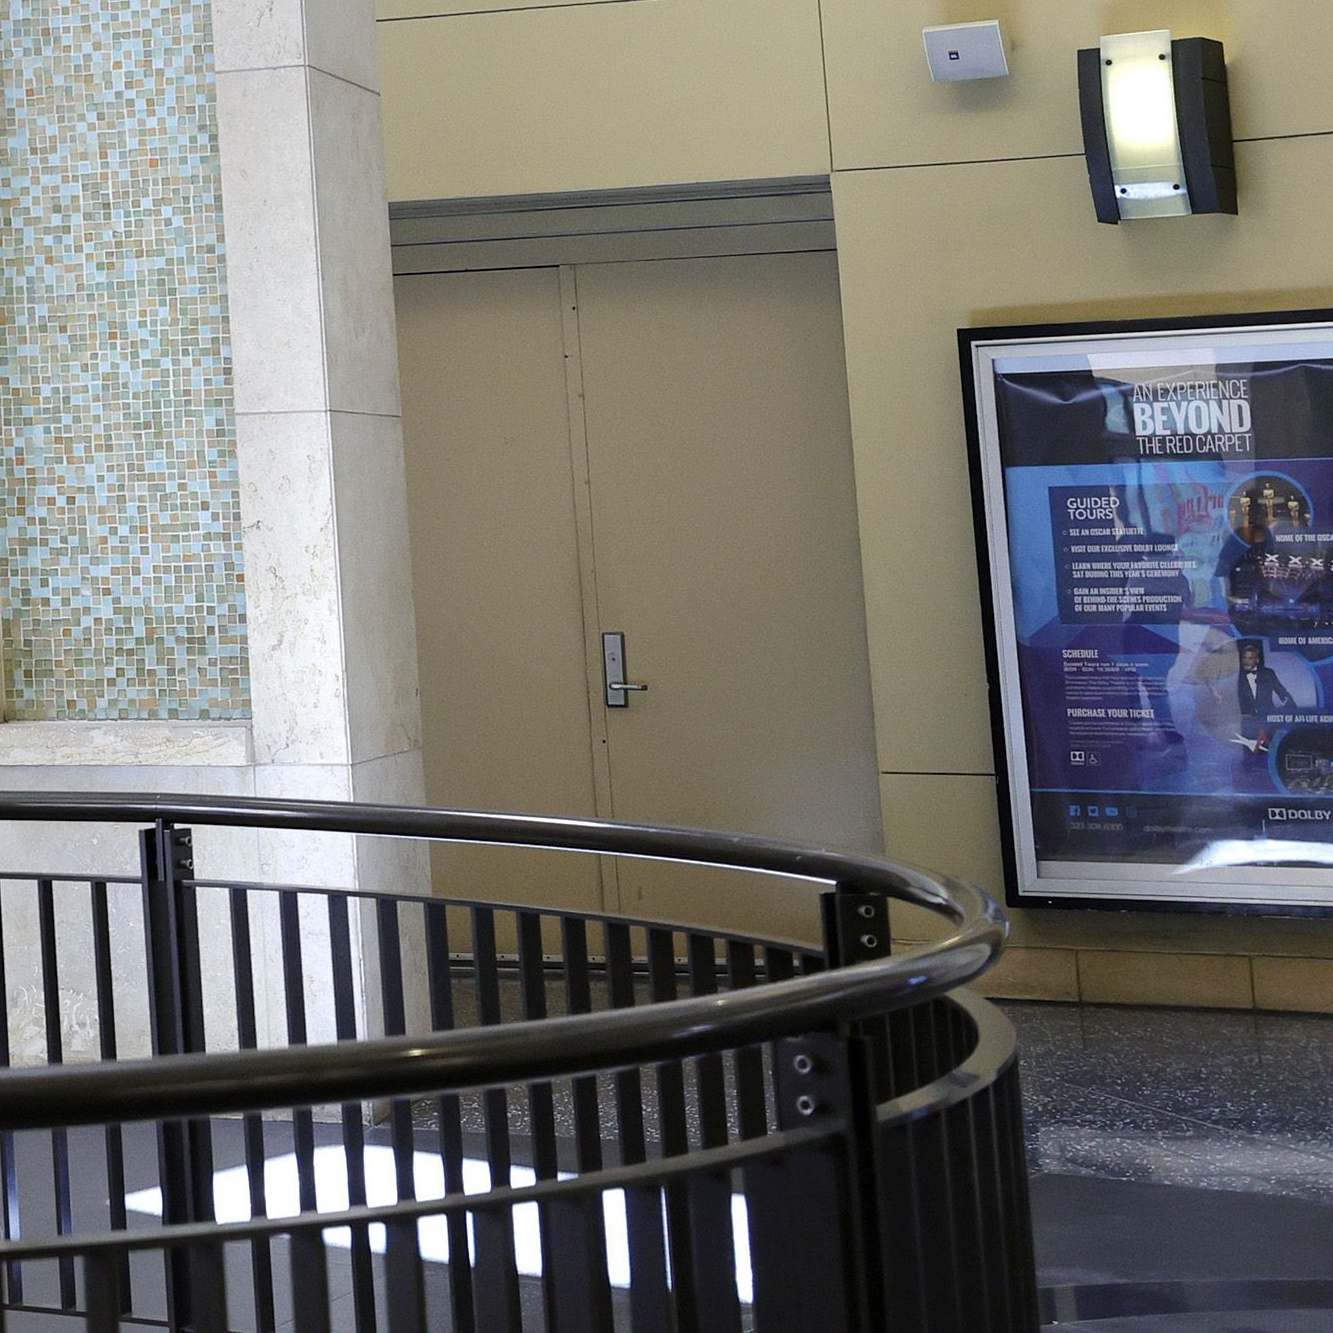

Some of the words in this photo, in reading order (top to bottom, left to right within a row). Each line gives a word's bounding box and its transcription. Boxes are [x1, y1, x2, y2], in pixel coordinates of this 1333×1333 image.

[1133, 384, 1152, 402] AN
[1157, 379, 1249, 402] EXPERIENCE
[1133, 399, 1252, 436] BEYOND
[1136, 436, 1164, 454] THE
[1166, 435, 1193, 454] RED
[1196, 433, 1252, 453] CARPET
[1067, 497, 1120, 509] GUIDED
[1068, 508, 1113, 520] TOURS
[1069, 528, 1079, 536] SEE
[1081, 528, 1090, 536] AN
[1090, 528, 1111, 536] OSCAR
[1275, 534, 1294, 542] HOME
[1295, 534, 1303, 542] OF
[1304, 534, 1316, 542] THE
[1071, 545, 1086, 553] VISIT
[1087, 545, 1100, 553] OUR
[1101, 545, 1133, 553] EXCLUSIVE
[1072, 562, 1091, 570] LEARN
[1073, 570, 1084, 578] SAT
[1085, 570, 1109, 578] DURING
[1110, 570, 1123, 578] THIS
[1074, 587, 1089, 595] GAIN
[1074, 595, 1082, 603] OF
[1142, 595, 1182, 603] PRODUCTION
[1075, 604, 1082, 612] OF
[1083, 604, 1097, 612] OUR
[1098, 604, 1115, 612] MANY
[1116, 604, 1144, 612] POPULAR
[1145, 604, 1167, 612] EVENTS
[1298, 636, 1306, 645] OF
[1062, 649, 1099, 658] SCHEDULE
[1067, 708, 1105, 718] PURCHASE
[1107, 708, 1128, 718] YOUR
[1130, 708, 1154, 718] TICKET
[1267, 714, 1284, 723] HOST
[1288, 809, 1331, 820] DOLBY
